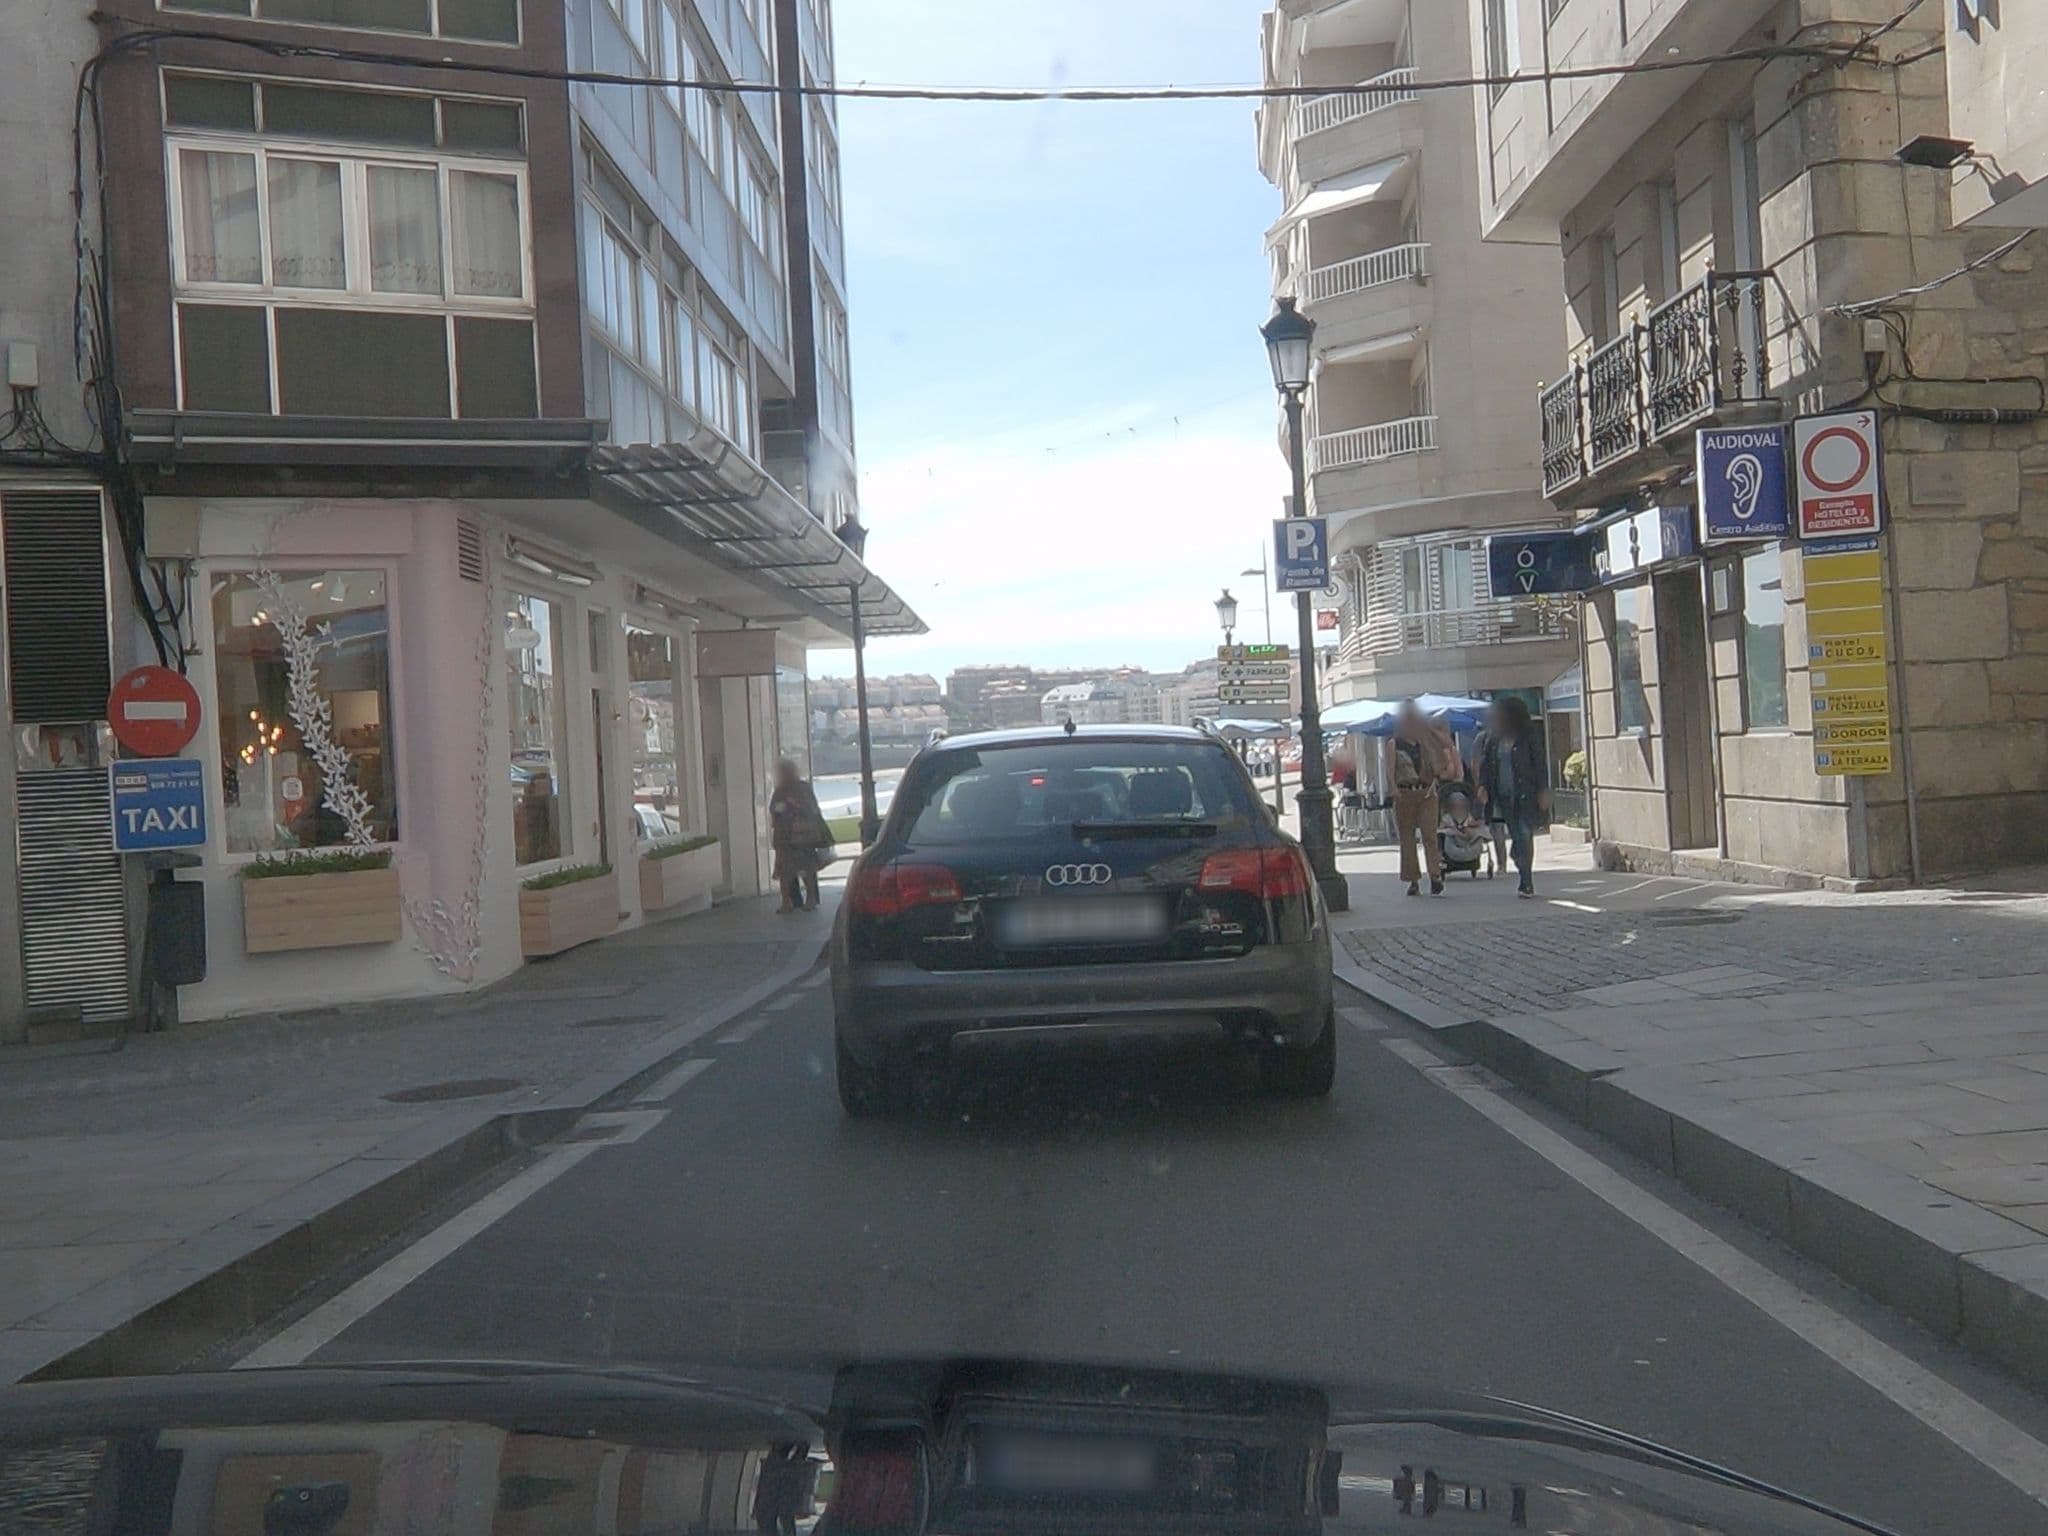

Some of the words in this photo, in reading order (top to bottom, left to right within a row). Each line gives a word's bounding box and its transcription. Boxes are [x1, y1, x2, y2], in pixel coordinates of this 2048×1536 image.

[1705, 433, 1780, 450] AUDIOVAL
[1815, 508, 1858, 519] HOTELES
[1808, 516, 1870, 529] RESIDENTES
[1709, 524, 1742, 535] Centro
[1287, 521, 1316, 559] P
[1246, 667, 1288, 676] FARMACIA
[121, 805, 198, 833] TAXI
